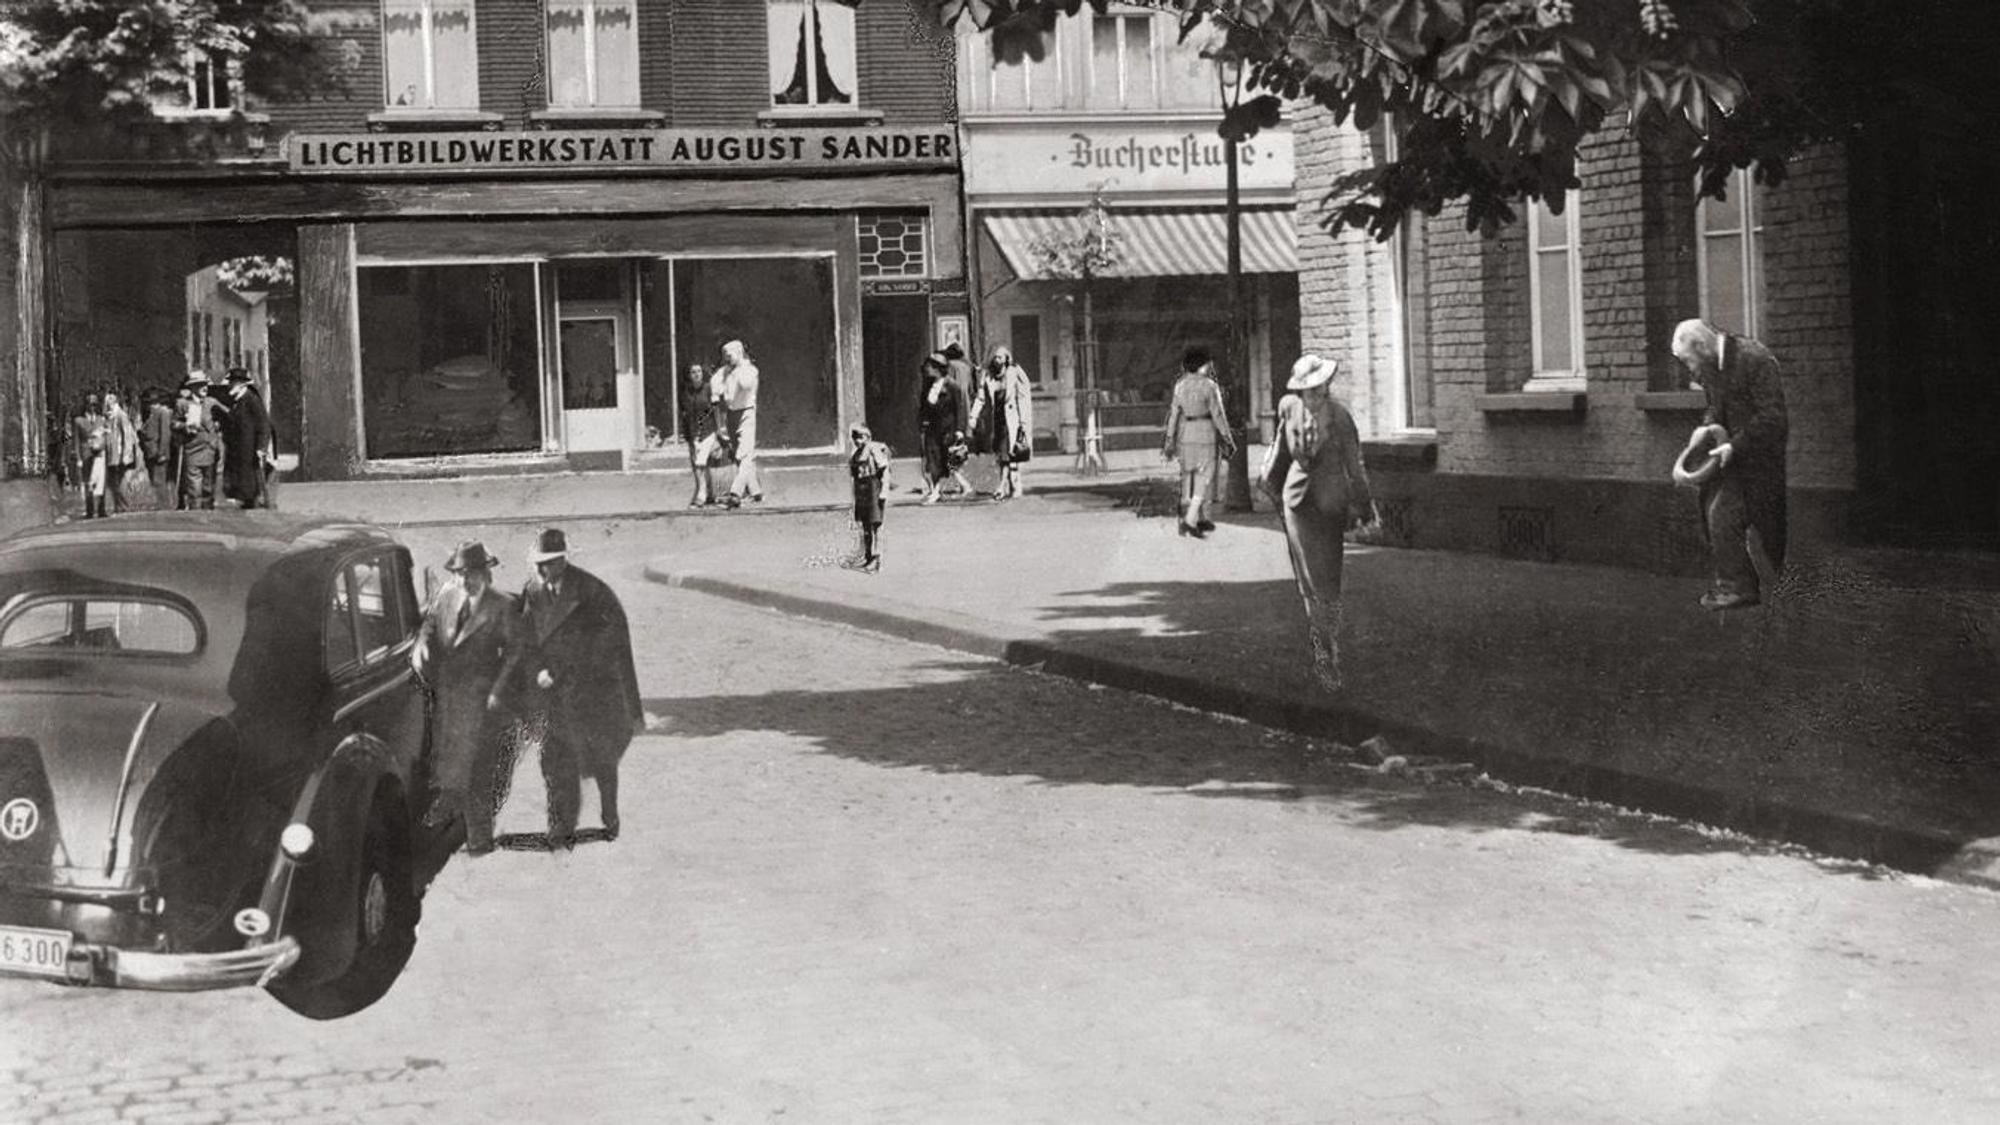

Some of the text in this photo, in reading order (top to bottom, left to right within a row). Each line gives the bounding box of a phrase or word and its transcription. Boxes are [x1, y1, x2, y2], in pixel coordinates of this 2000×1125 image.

[301, 134, 952, 166] LICHTBILDWERKSTATT AUGUST SANDER
